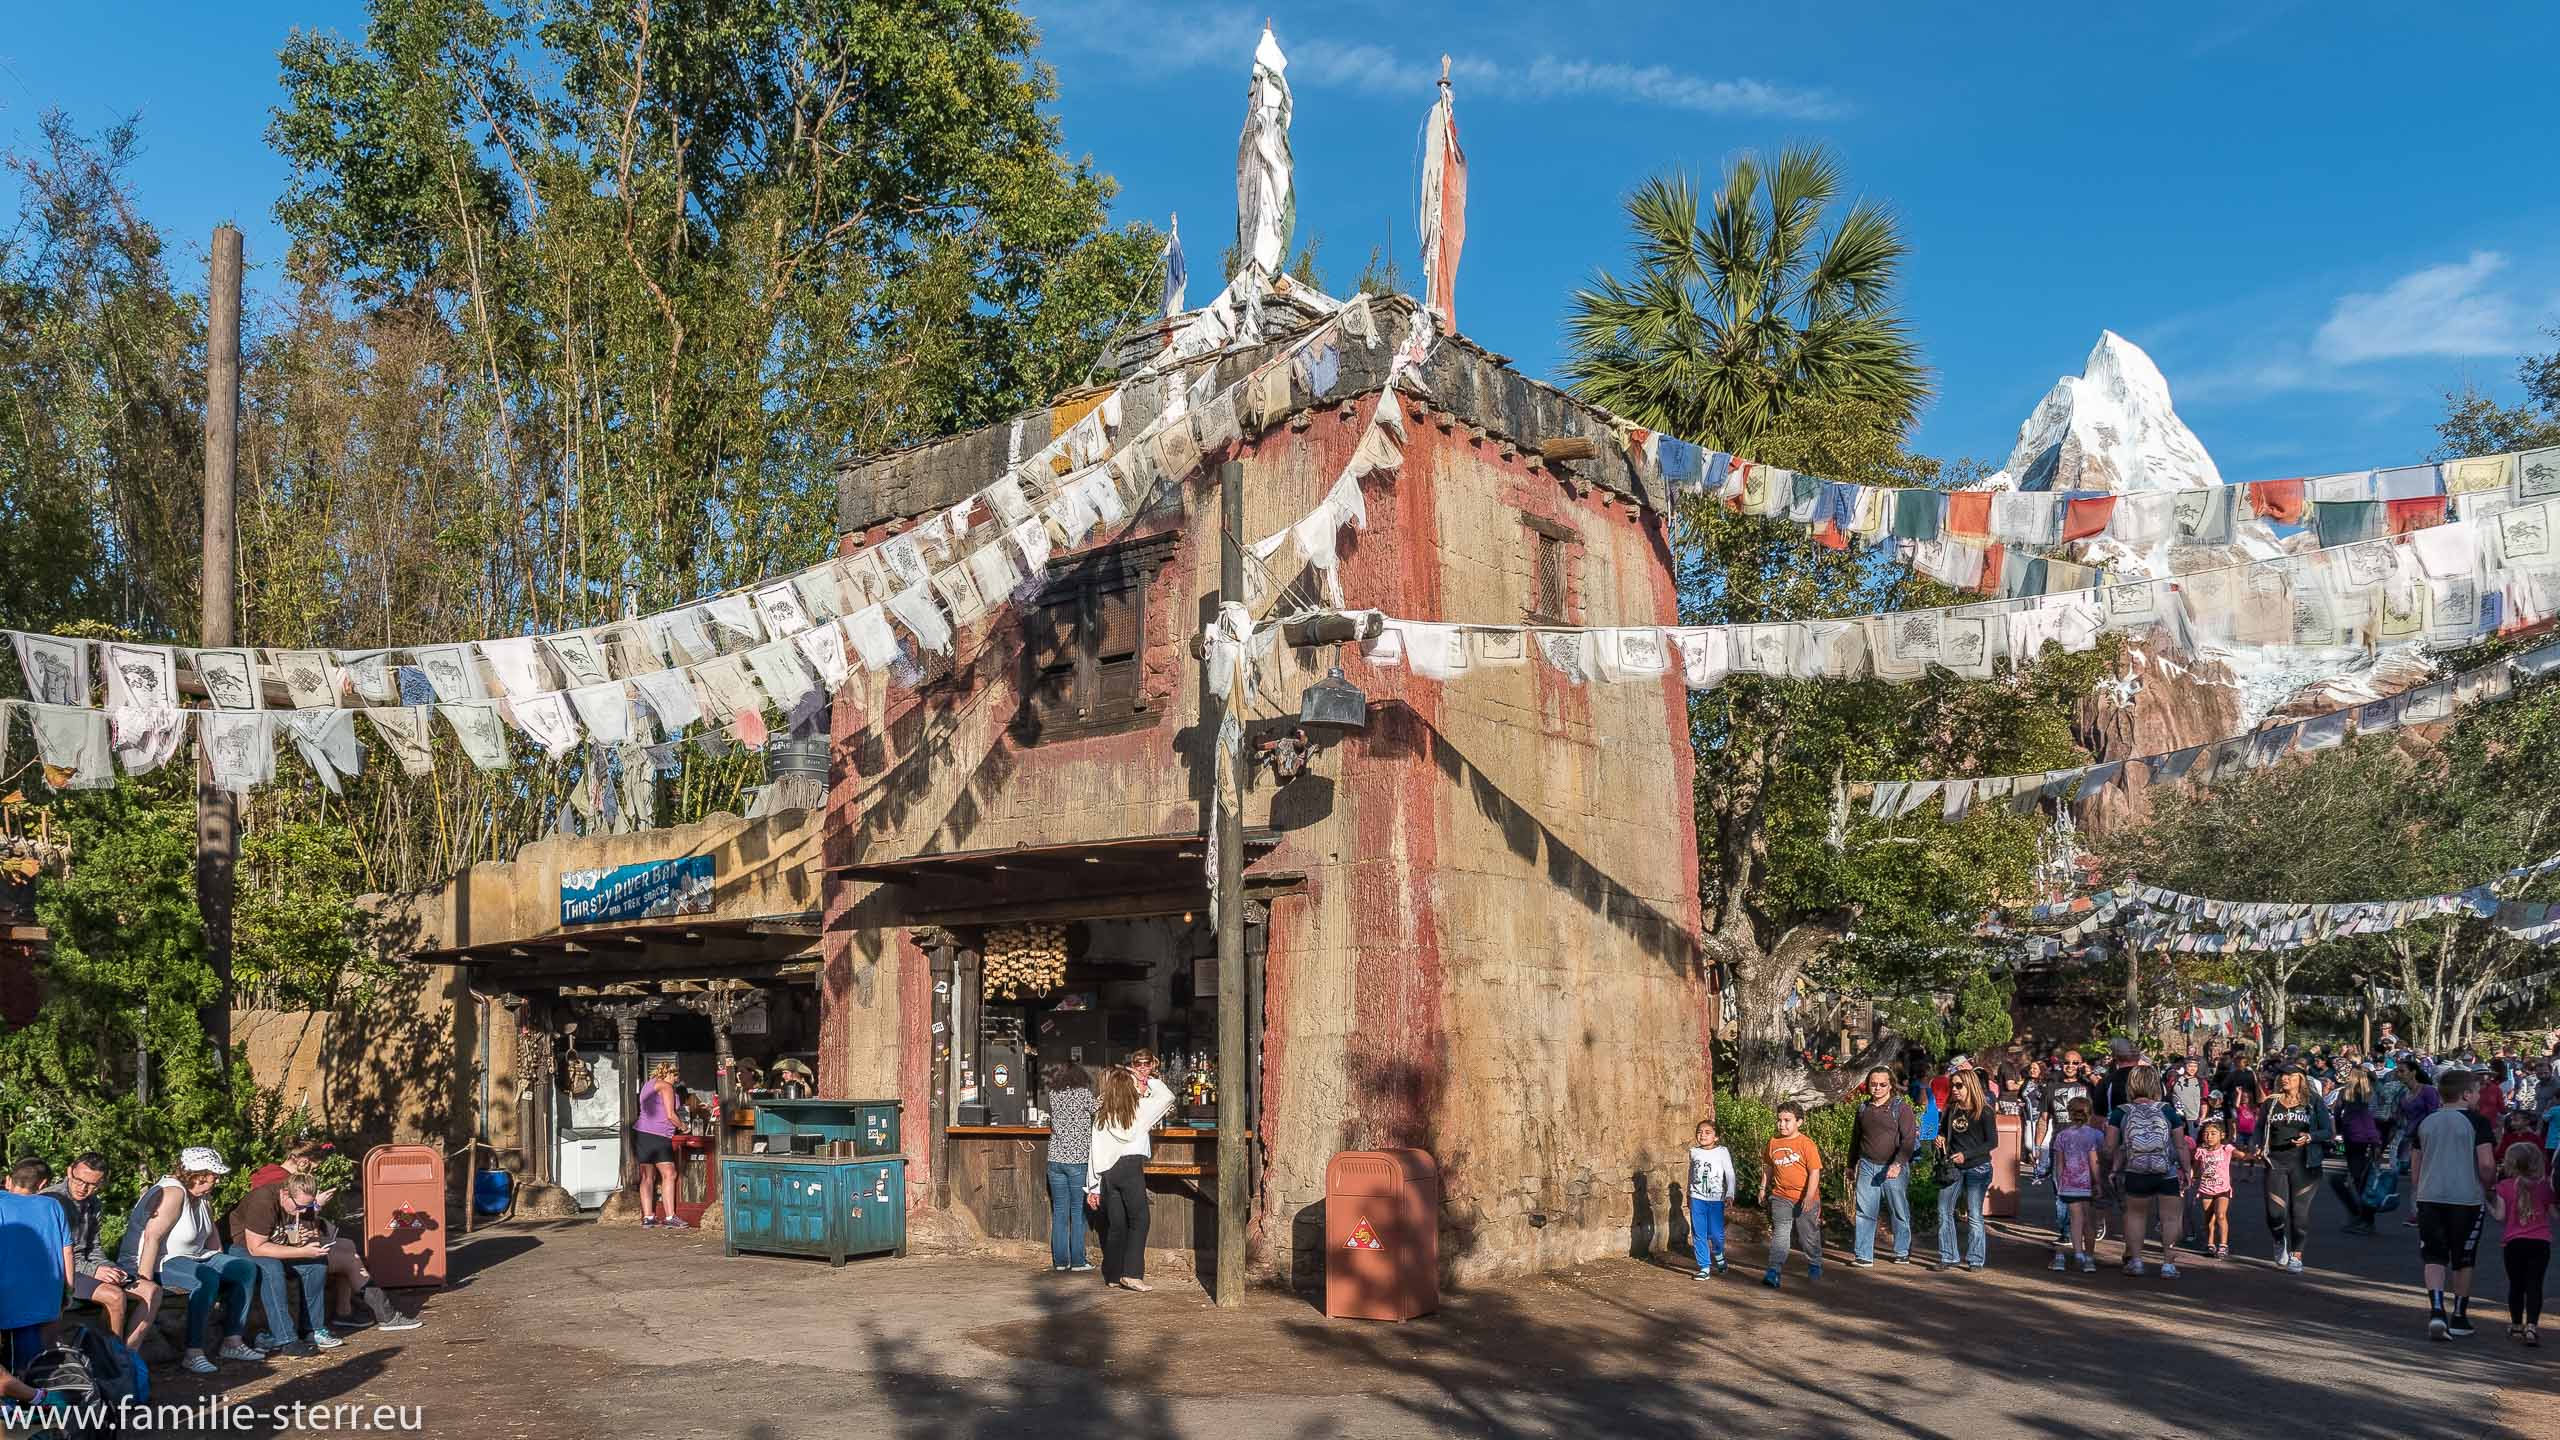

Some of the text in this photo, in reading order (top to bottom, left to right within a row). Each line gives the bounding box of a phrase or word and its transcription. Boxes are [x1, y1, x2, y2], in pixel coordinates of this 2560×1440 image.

[563, 862, 678, 920] THIRSTY RIVER BAR
[623, 896, 641, 912] TREK
